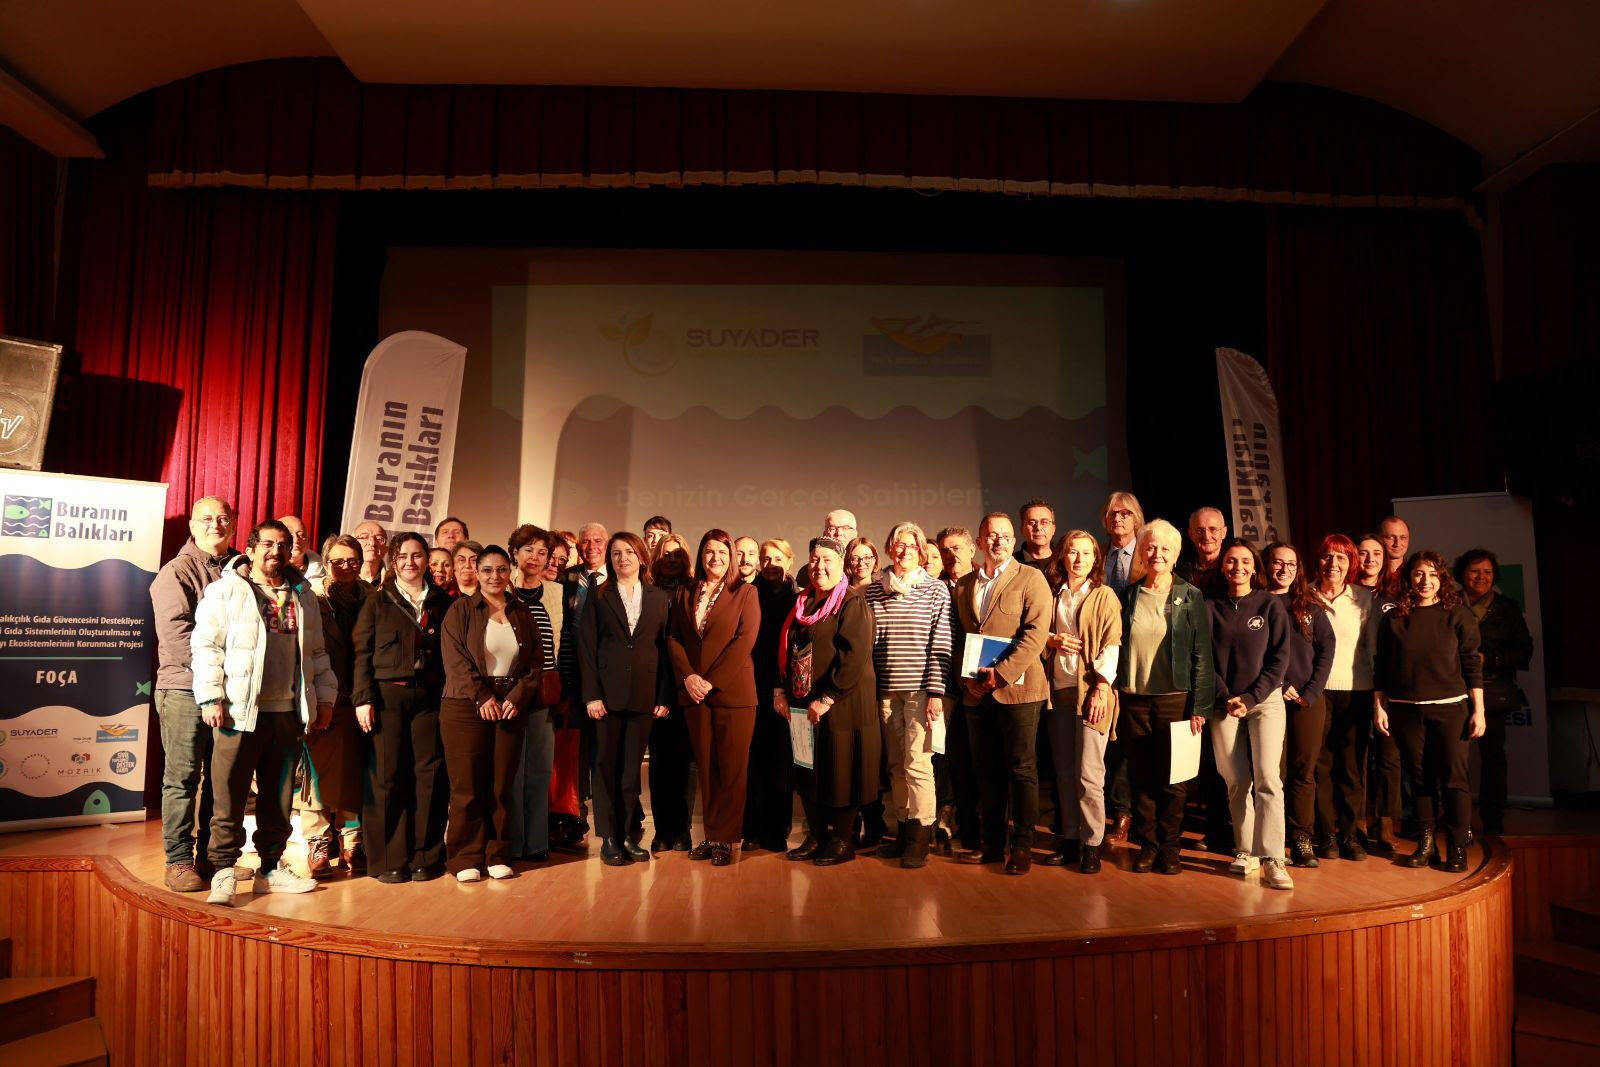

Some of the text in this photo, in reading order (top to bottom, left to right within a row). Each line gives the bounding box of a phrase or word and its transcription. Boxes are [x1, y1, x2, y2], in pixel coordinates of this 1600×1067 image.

[686, 328, 820, 348] SUYADER
[364, 401, 408, 523] Buranın
[402, 406, 444, 526] Balıkları
[616, 482, 723, 507] Denizin
[734, 480, 846, 511] Gerçek
[56, 501, 128, 521] Buranın
[54, 522, 133, 542] Balıkları
[33, 615, 51, 623] Gıda
[53, 616, 99, 624] Güvencesini
[100, 617, 144, 627] Destekliyor:
[4, 627, 22, 635] Gıda
[25, 627, 76, 636] Sistemlerinin
[79, 628, 131, 637] Oluşturulması
[9, 639, 74, 648] Ekosistemlerinin
[76, 640, 117, 648] Korunması
[119, 640, 144, 650] Projesi
[35, 670, 78, 687] FOÇA
[10, 728, 59, 737] SUYADER
